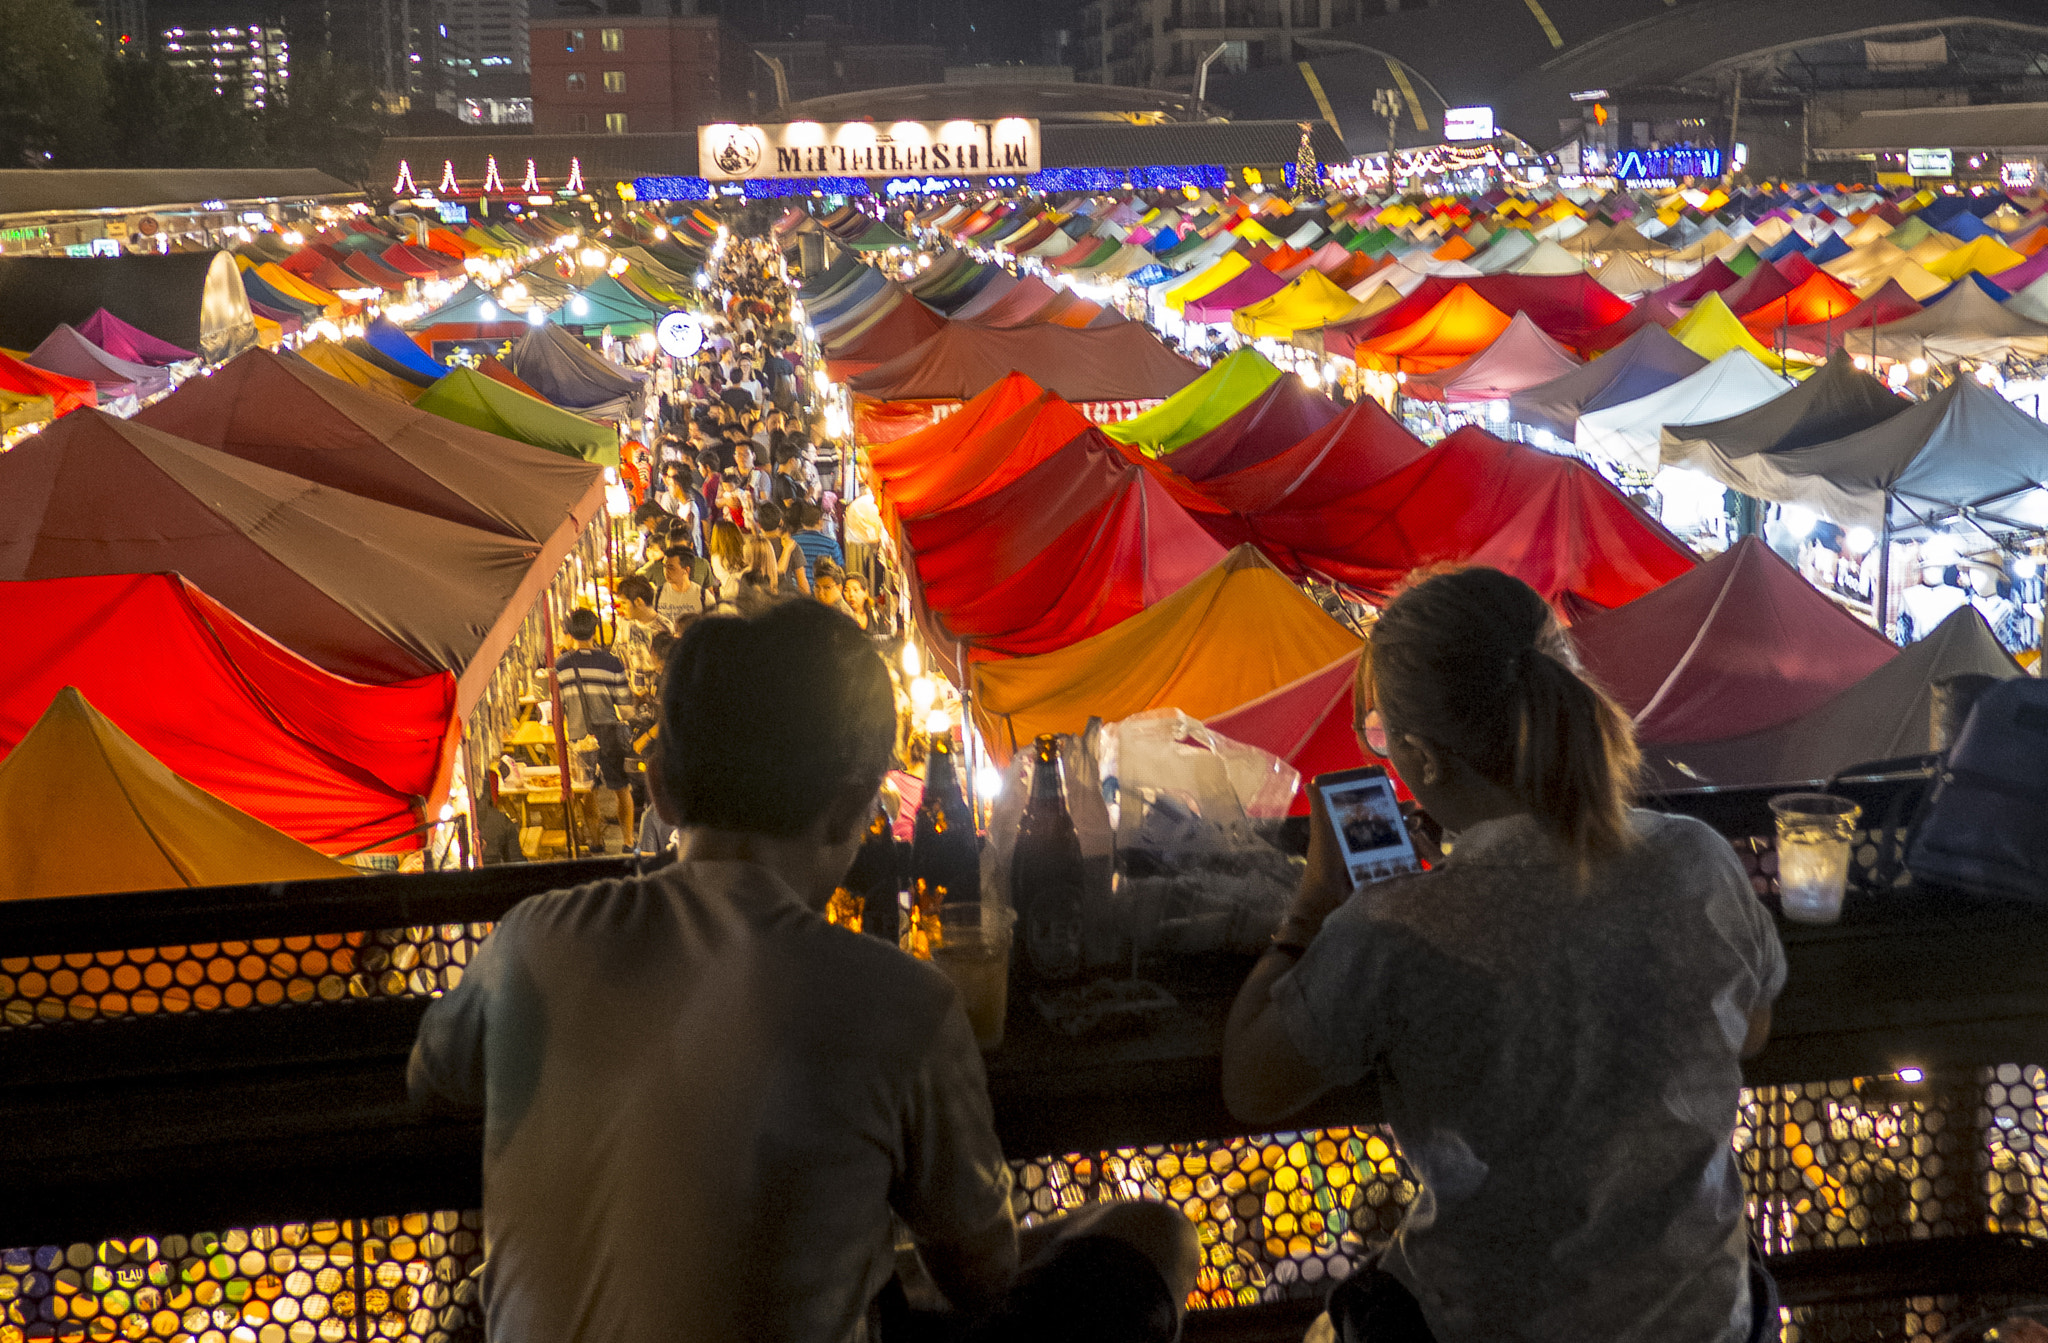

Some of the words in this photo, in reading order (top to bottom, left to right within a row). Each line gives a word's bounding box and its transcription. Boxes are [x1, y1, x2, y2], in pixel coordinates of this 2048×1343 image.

[776, 123, 1028, 173] ตลาดนัดรถไฟ
